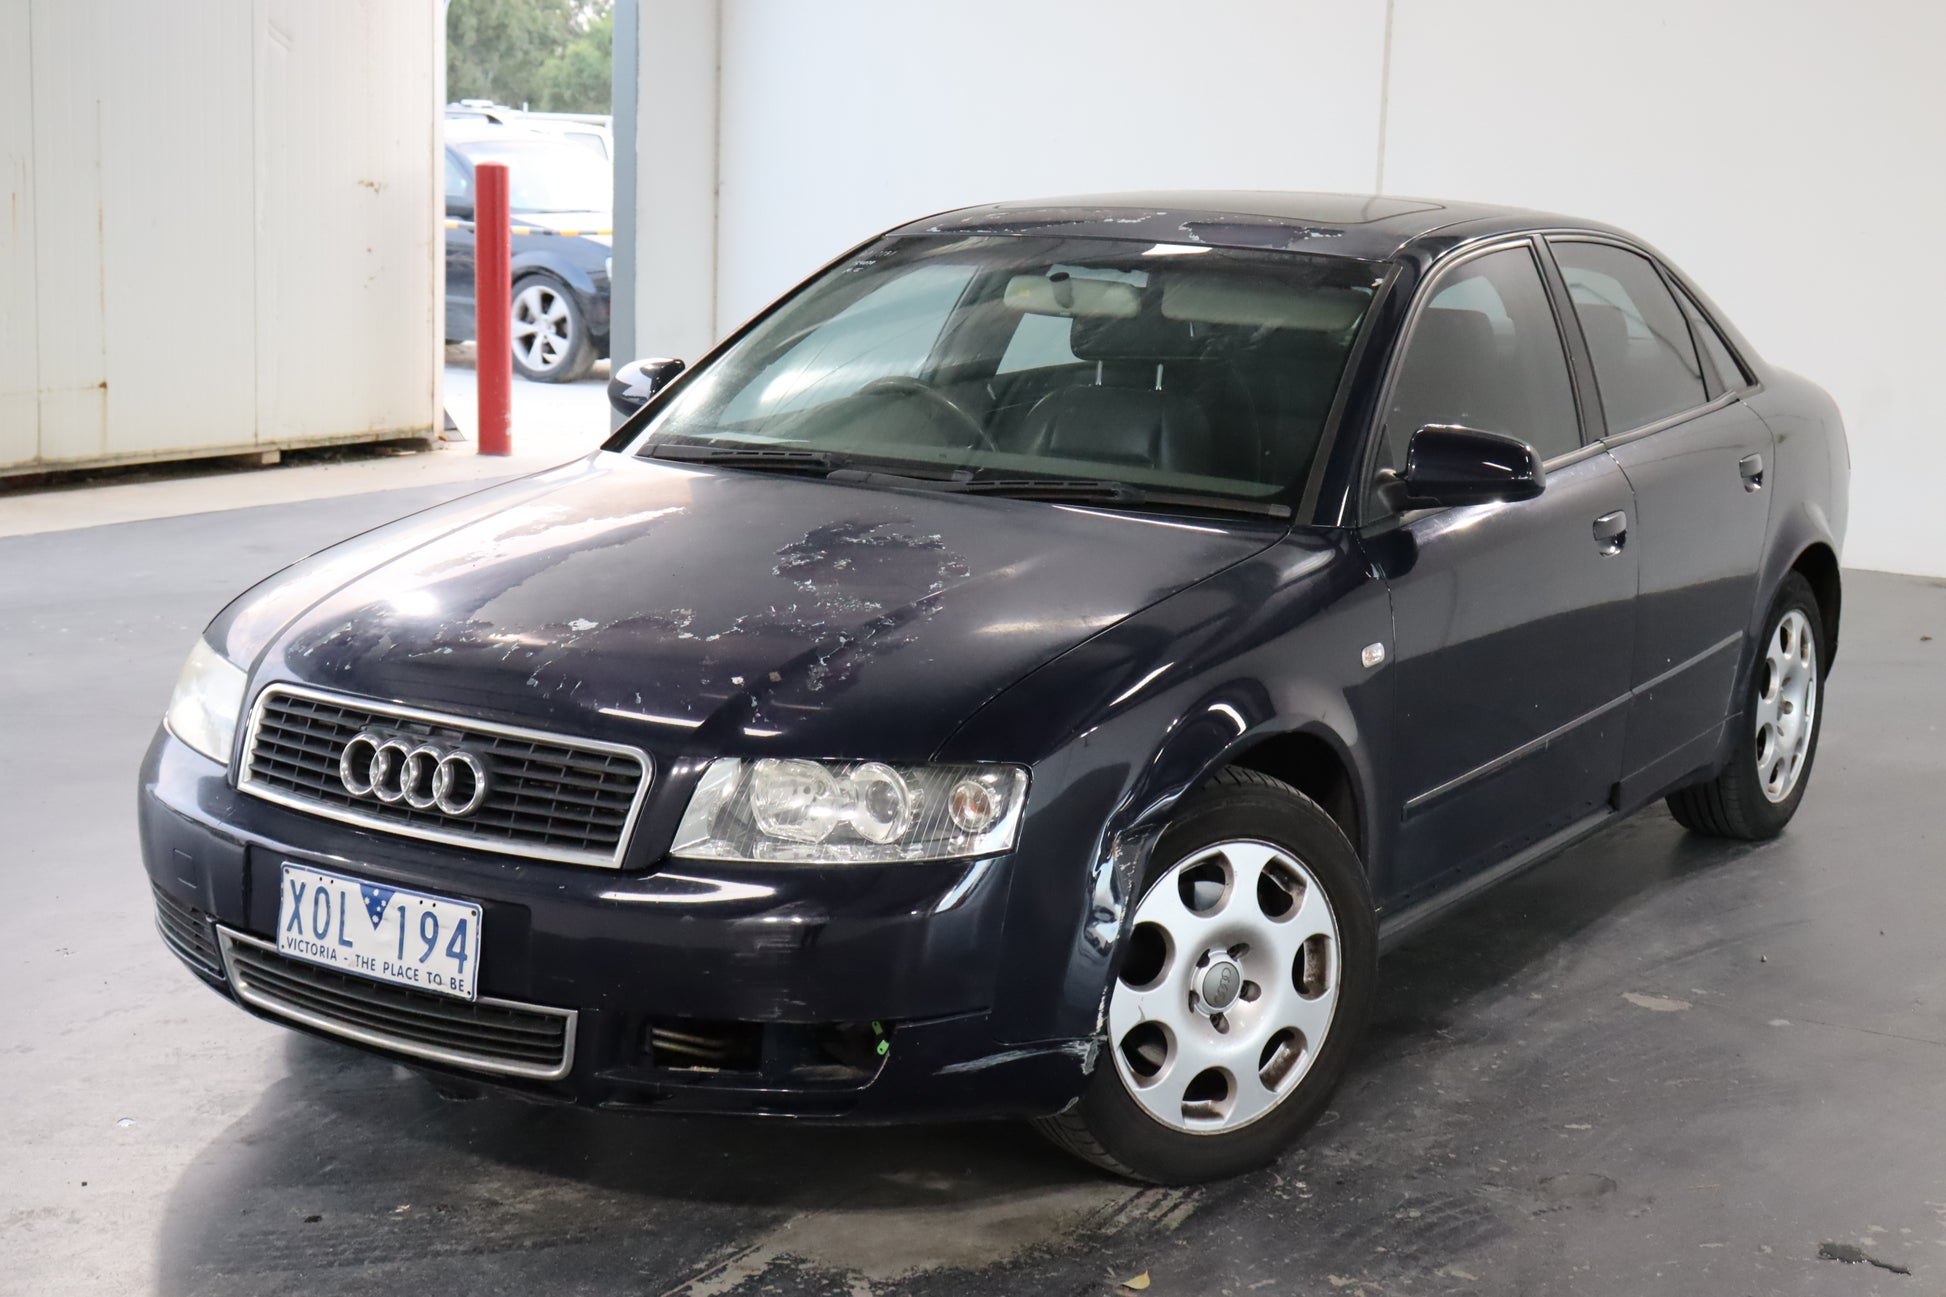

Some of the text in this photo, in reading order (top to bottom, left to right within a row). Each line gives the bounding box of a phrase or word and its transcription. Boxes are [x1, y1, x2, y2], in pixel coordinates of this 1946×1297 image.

[286, 879, 468, 974] XOL 194
[286, 937, 338, 961] VICTORIA
[354, 954, 376, 972] THE
[383, 961, 420, 982] PLACE
[426, 971, 443, 986] TO
[450, 977, 465, 993] BE
